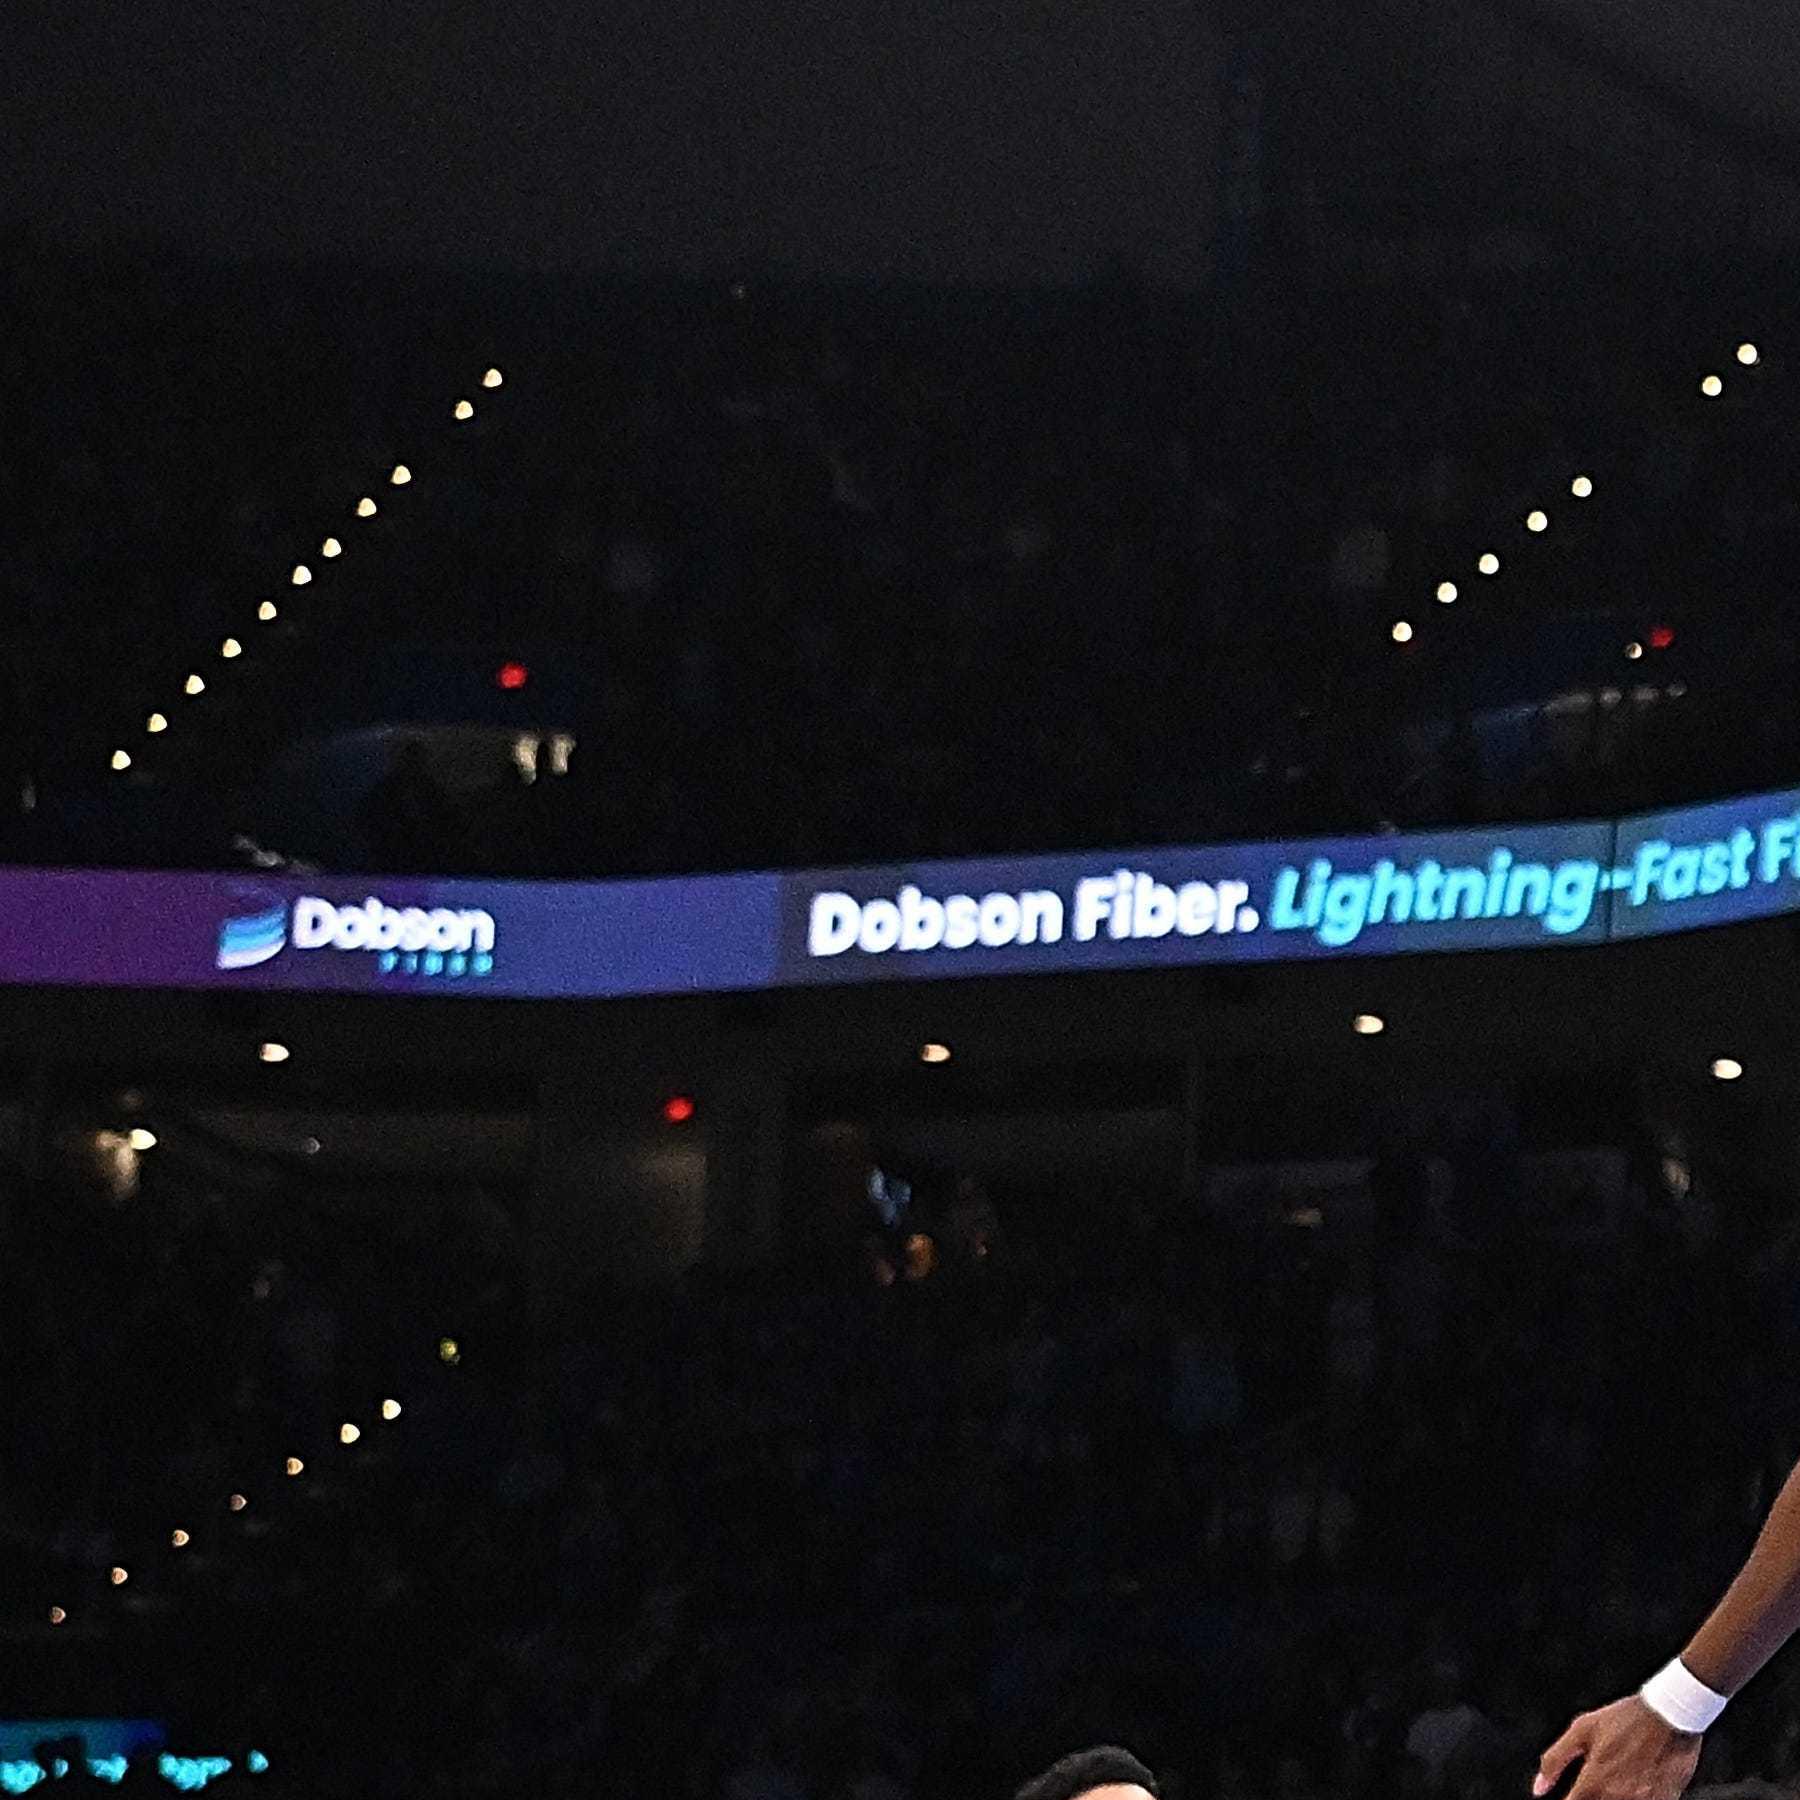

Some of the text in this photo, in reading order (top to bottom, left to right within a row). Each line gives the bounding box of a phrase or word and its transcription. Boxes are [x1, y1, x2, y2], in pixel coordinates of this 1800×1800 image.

[292, 894, 497, 953] Dobson
[810, 884, 1064, 957] Dobson
[1074, 867, 1260, 942] Fiber.
[1270, 825, 1753, 947] Lightning-Fast
